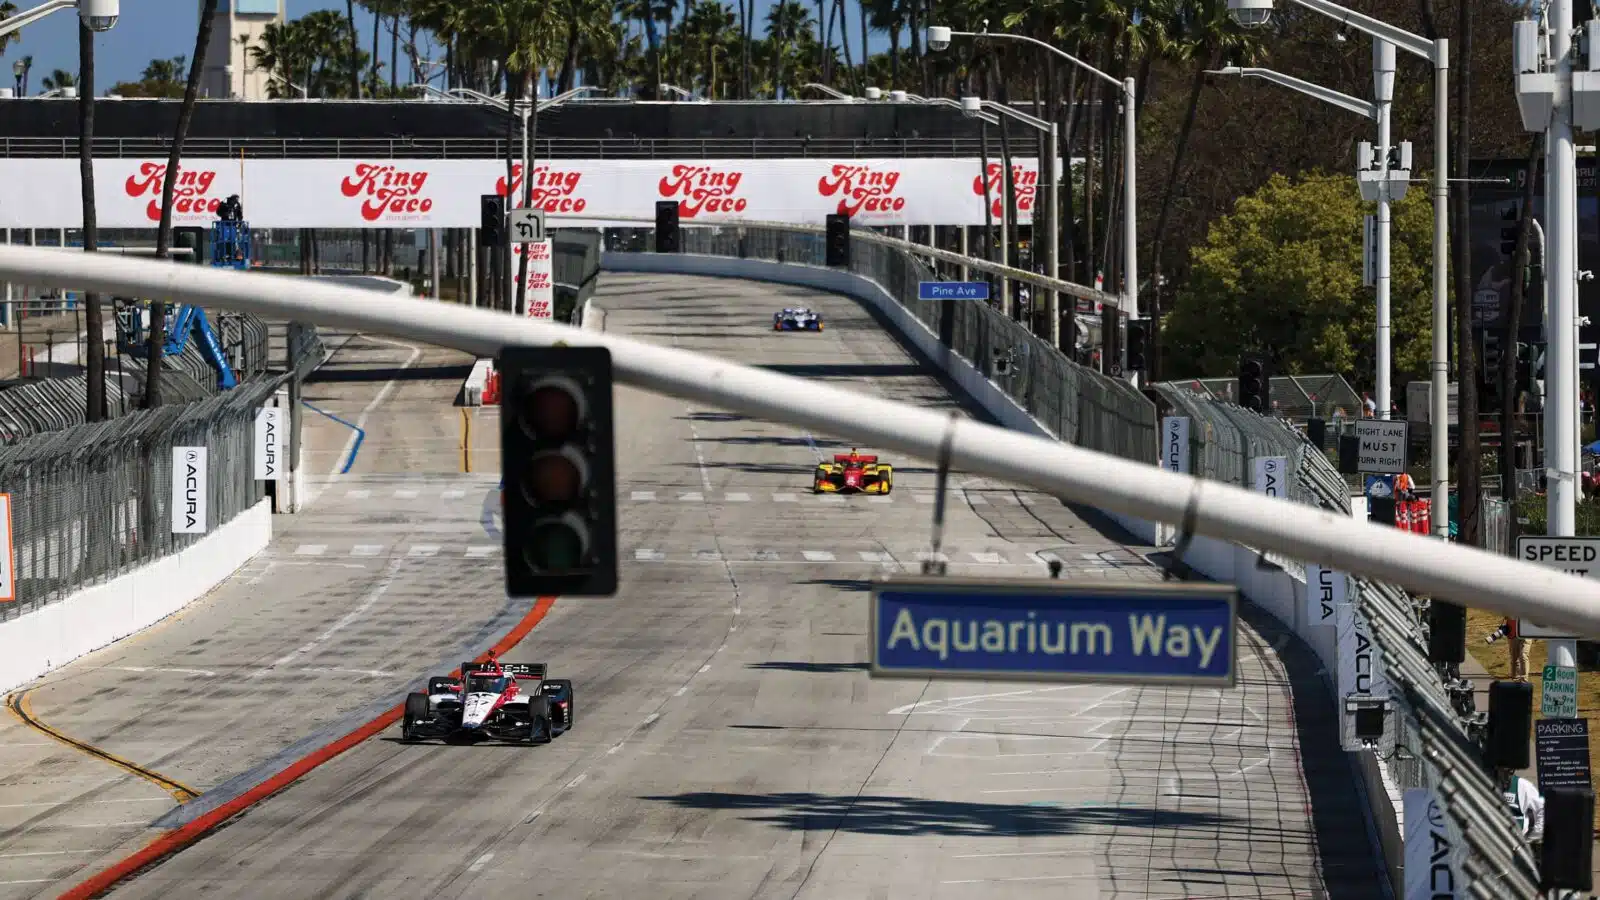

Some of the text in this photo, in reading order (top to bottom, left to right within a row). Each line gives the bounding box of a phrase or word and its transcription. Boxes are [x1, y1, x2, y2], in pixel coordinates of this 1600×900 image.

[341, 164, 428, 197] King
[659, 165, 742, 197] King
[818, 165, 900, 196] King
[973, 163, 1036, 195] Kin
[361, 188, 432, 221] Taco
[678, 188, 747, 218] Taco
[837, 187, 905, 217] Taco
[991, 186, 1035, 218] Ta
[932, 287, 976, 295] Pine Ave
[1358, 428, 1380, 436] RIGHT
[1363, 441, 1396, 452] MUST
[265, 422, 275, 476] ACURA
[1170, 431, 1179, 472] ACUR
[1380, 457, 1401, 466] RIGHT
[186, 463, 197, 528] ACURA
[1525, 545, 1596, 561] SPEED
[1319, 567, 1333, 620] URA
[888, 608, 1222, 669] Aquarium Way
[1355, 632, 1371, 694] ACU
[1546, 668, 1553, 679] 2
[1545, 682, 1574, 692] PARKING
[1538, 724, 1583, 733] PARKING
